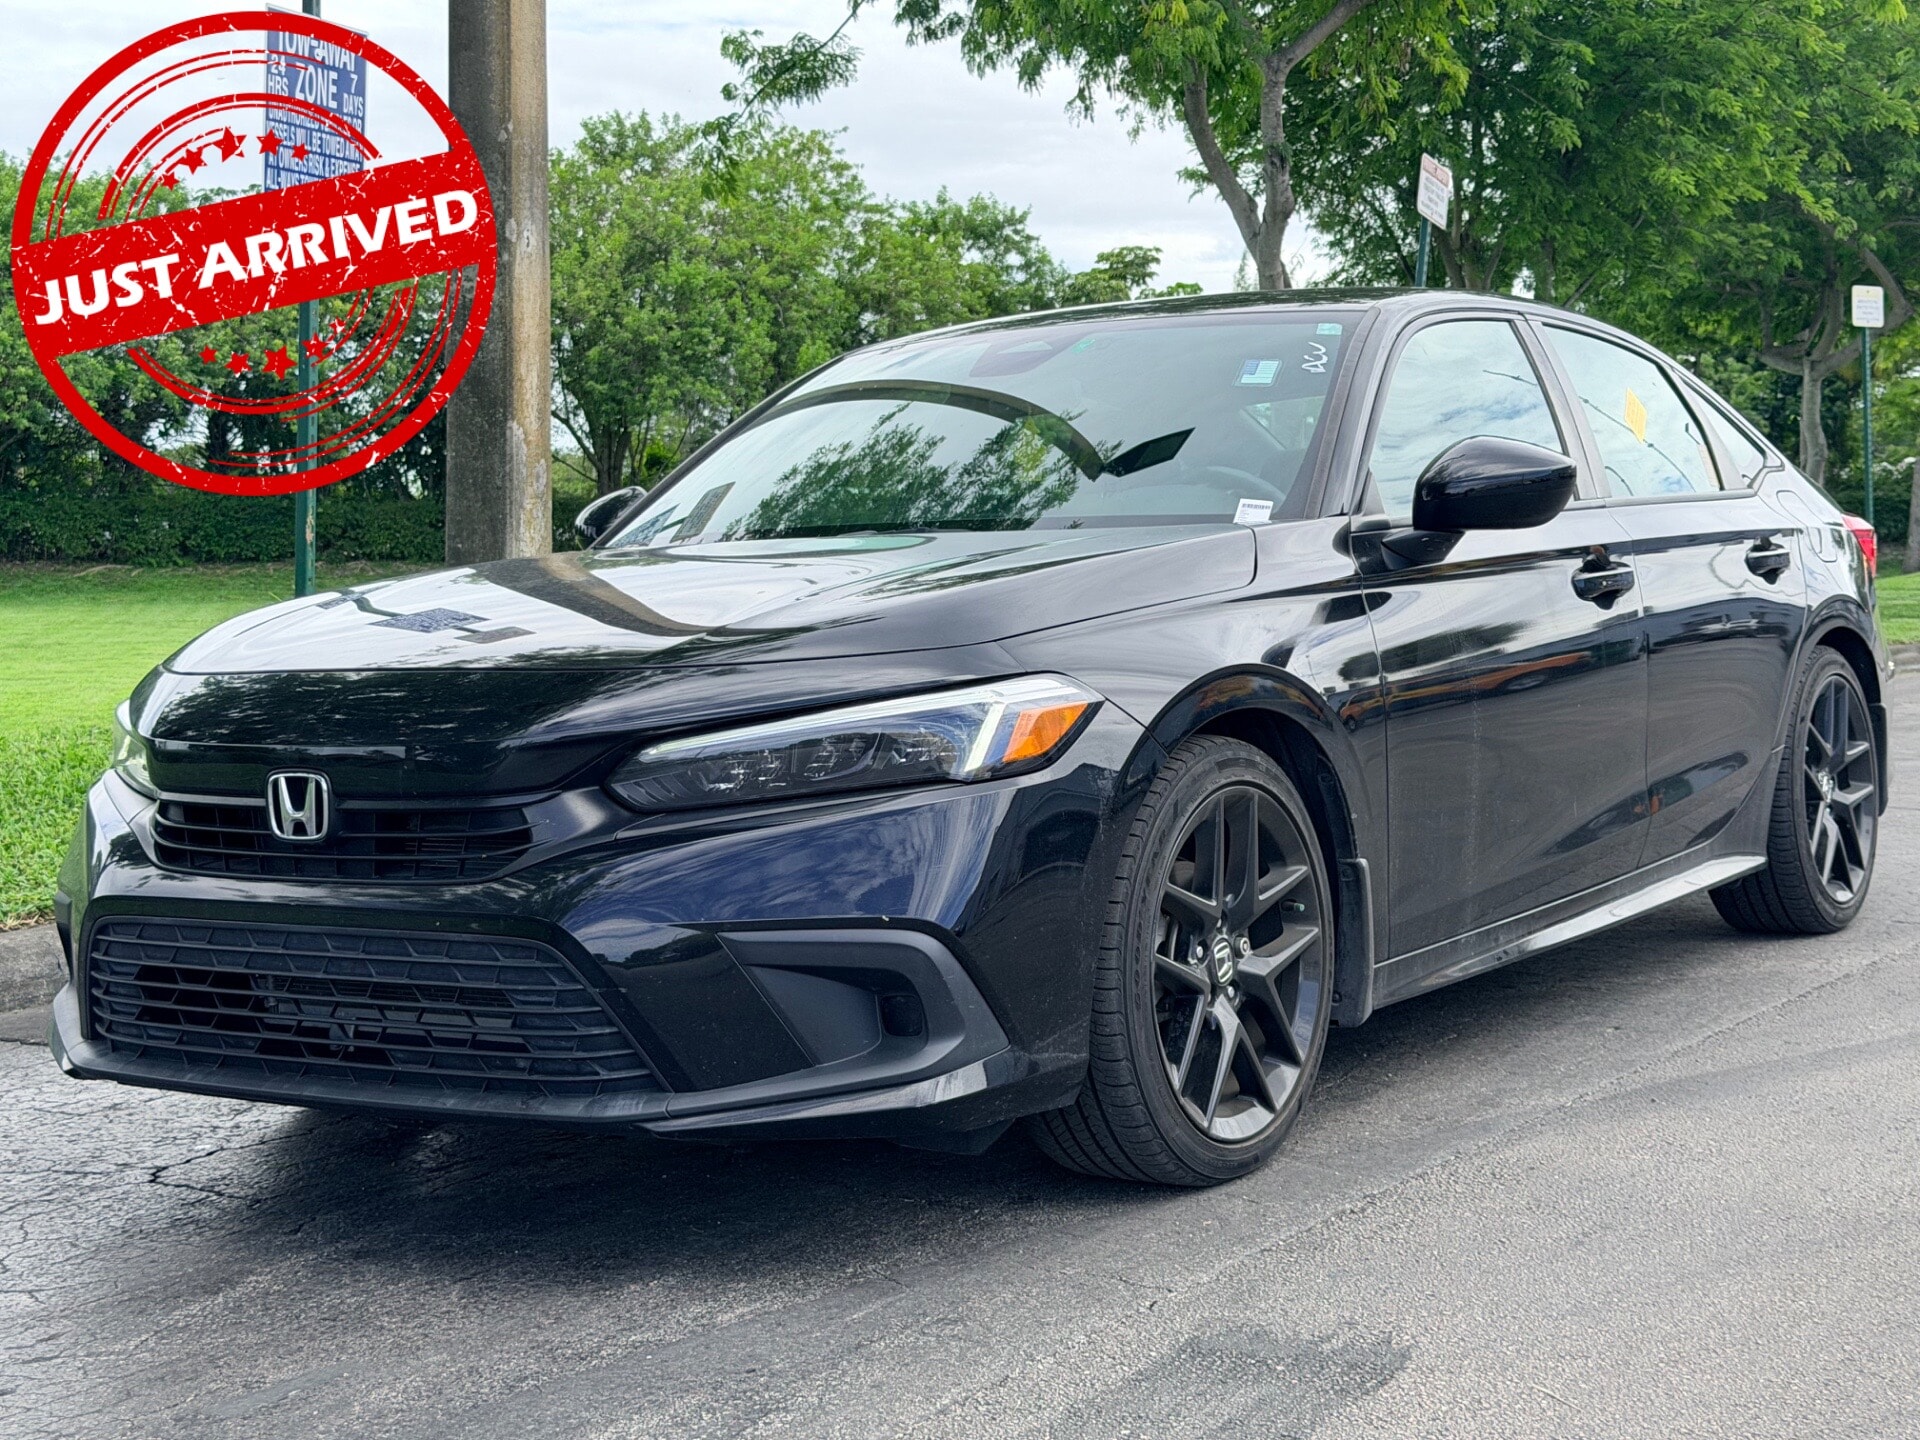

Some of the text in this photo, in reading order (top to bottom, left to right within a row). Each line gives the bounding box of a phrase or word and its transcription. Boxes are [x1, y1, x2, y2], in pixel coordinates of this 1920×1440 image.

[270, 54, 286, 76] 24
[267, 74, 289, 97] HRS
[295, 62, 338, 109] ZONE
[350, 73, 359, 94] 7
[343, 93, 364, 117] DAYS
[312, 131, 321, 153] BE
[321, 134, 345, 158] TOWED
